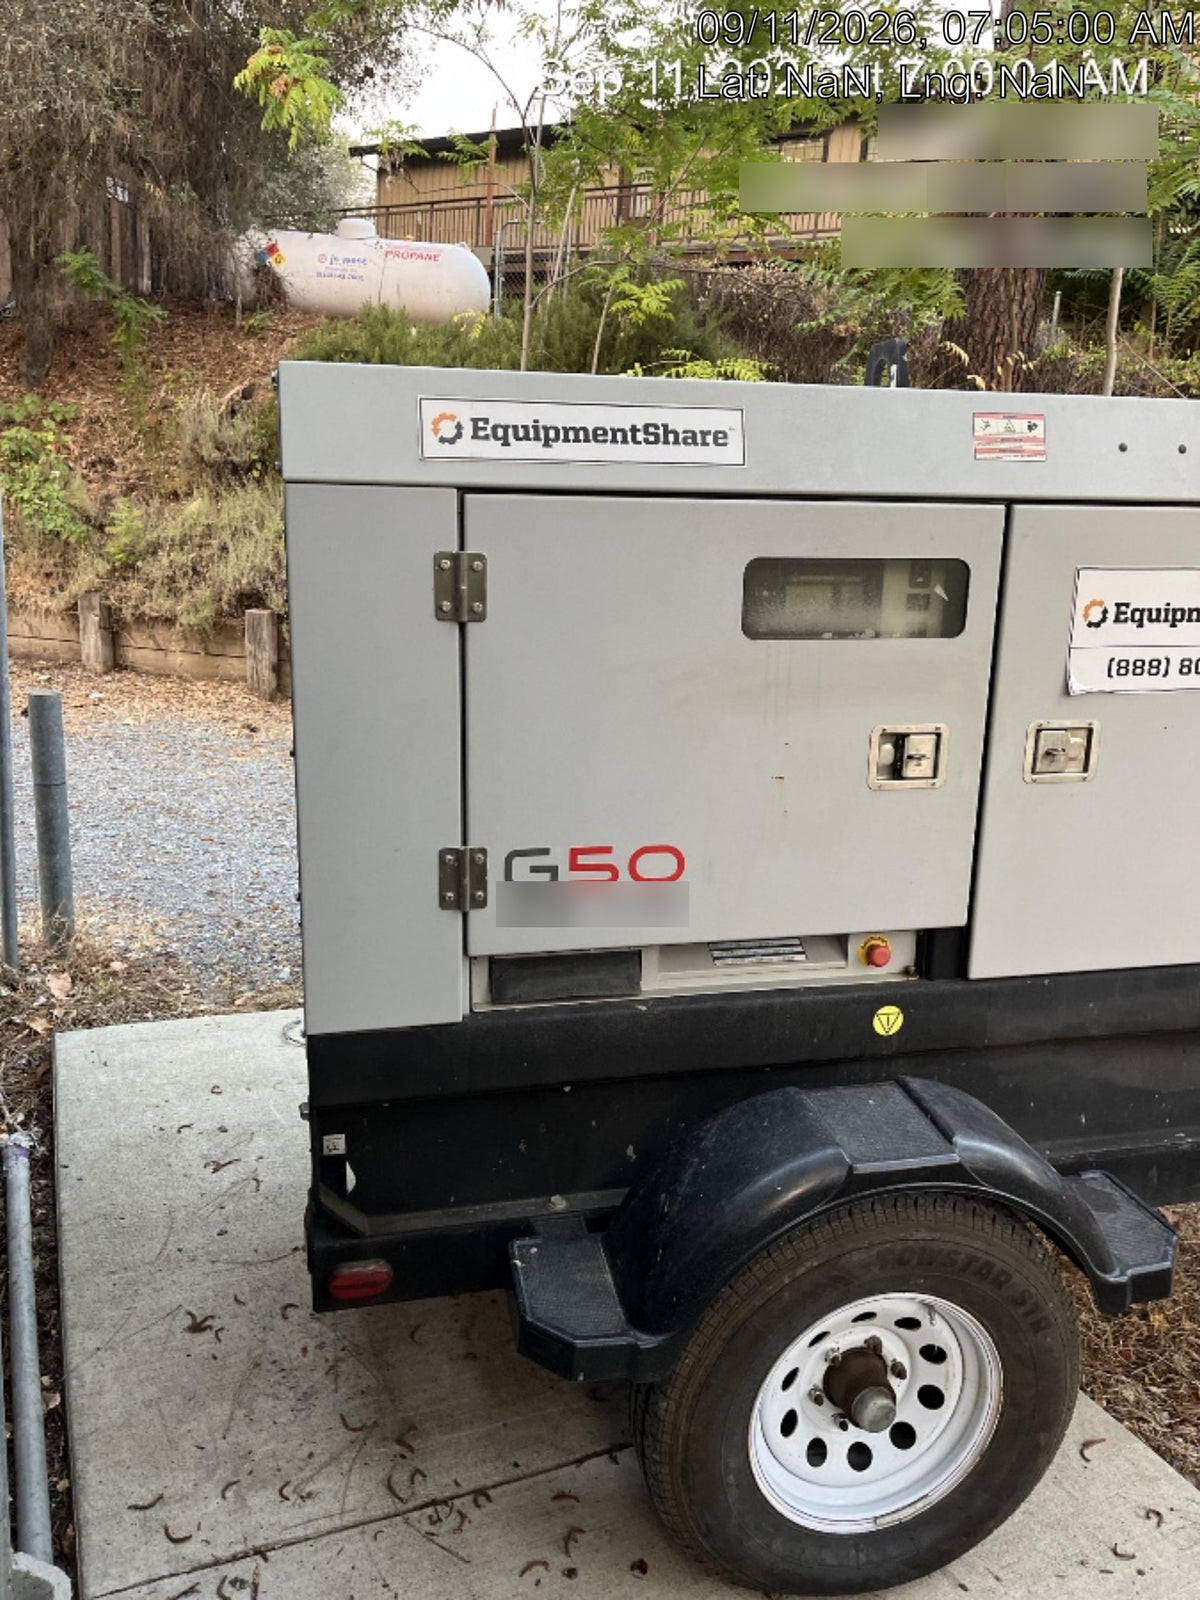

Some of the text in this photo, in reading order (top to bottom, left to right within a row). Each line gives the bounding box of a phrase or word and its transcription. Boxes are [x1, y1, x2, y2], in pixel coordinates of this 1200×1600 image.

[384, 249, 441, 262] PROPANE
[469, 417, 729, 448] EquipmentShare
[1107, 657, 1170, 678] (888)
[504, 844, 686, 881] G50
